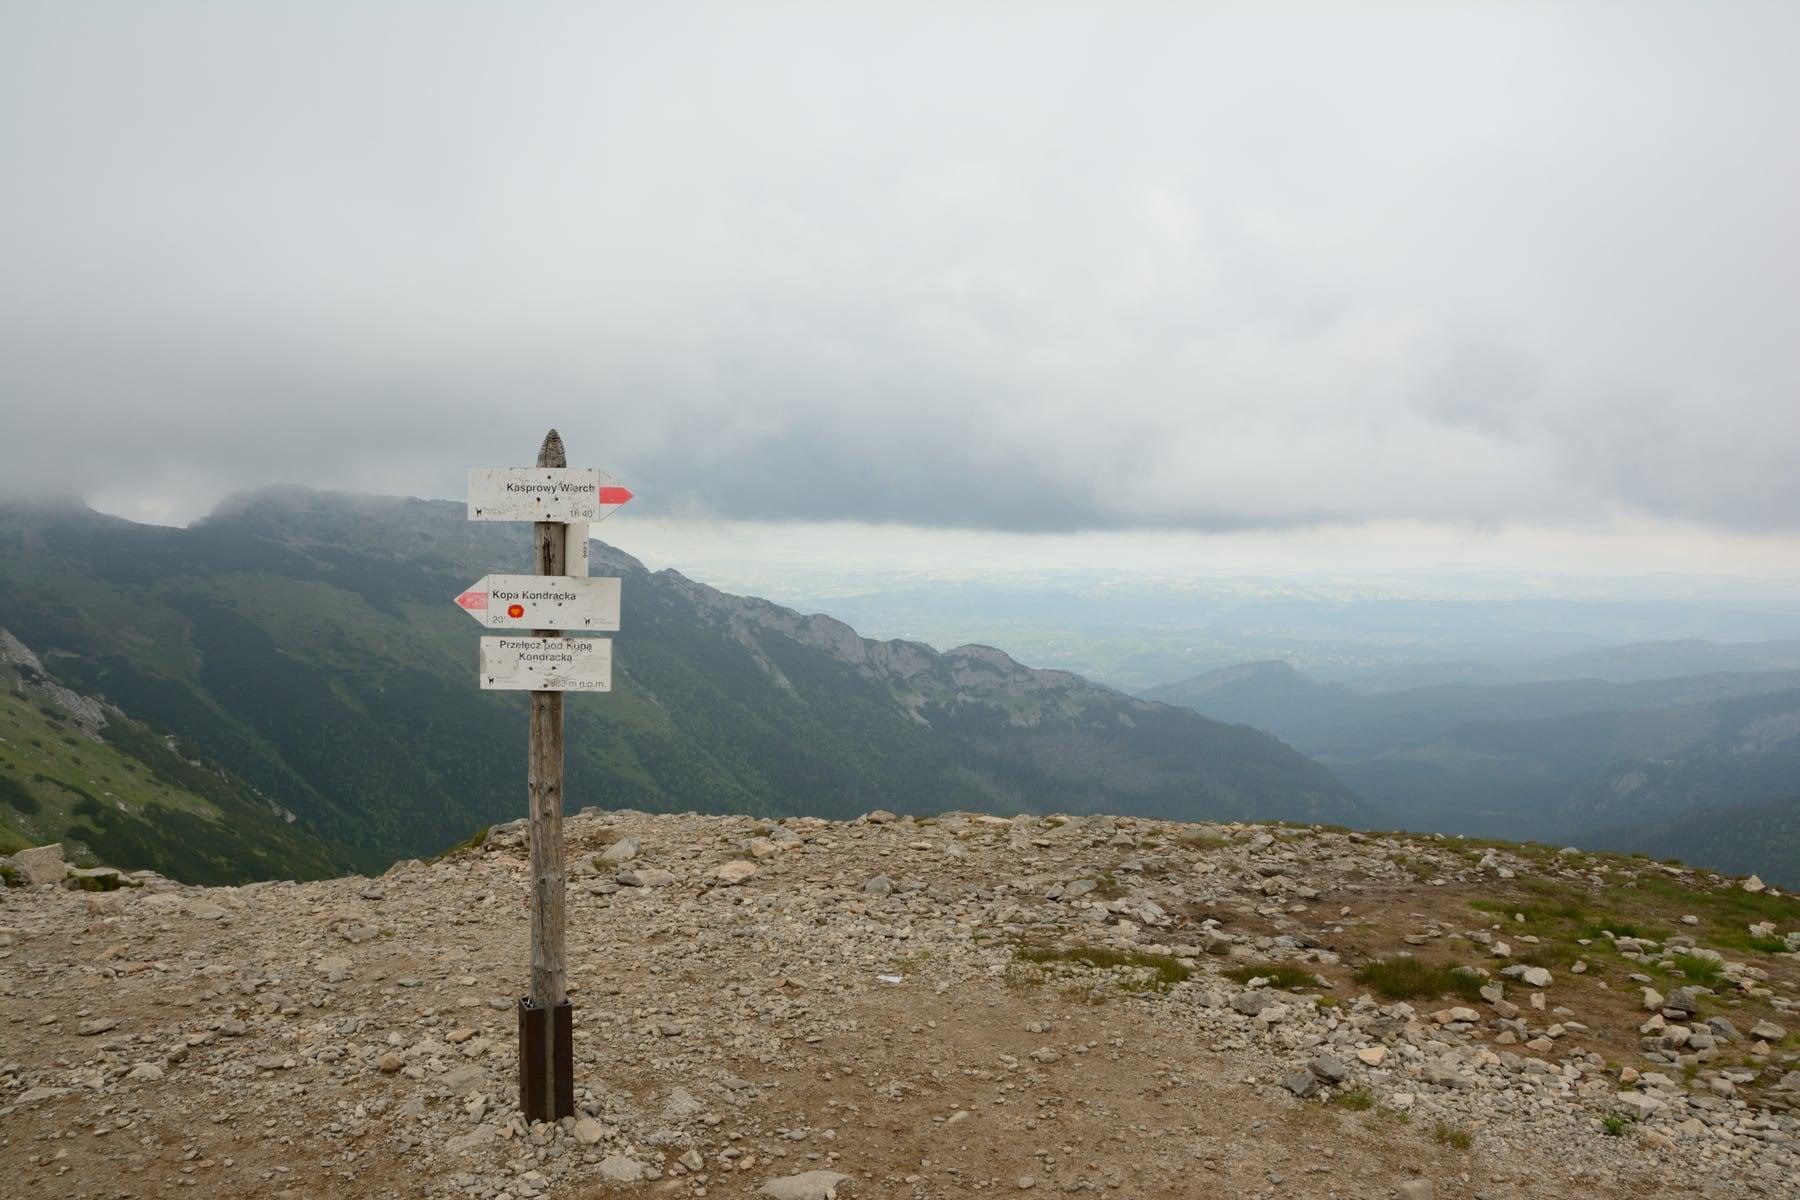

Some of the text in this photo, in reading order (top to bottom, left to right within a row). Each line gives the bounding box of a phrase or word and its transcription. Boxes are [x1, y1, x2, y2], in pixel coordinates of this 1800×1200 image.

[506, 483, 595, 494] Kasprowy Wierch
[492, 590, 576, 601] Kopa Kondracka
[500, 640, 541, 651] Przełęcz
[544, 641, 563, 651] pod
